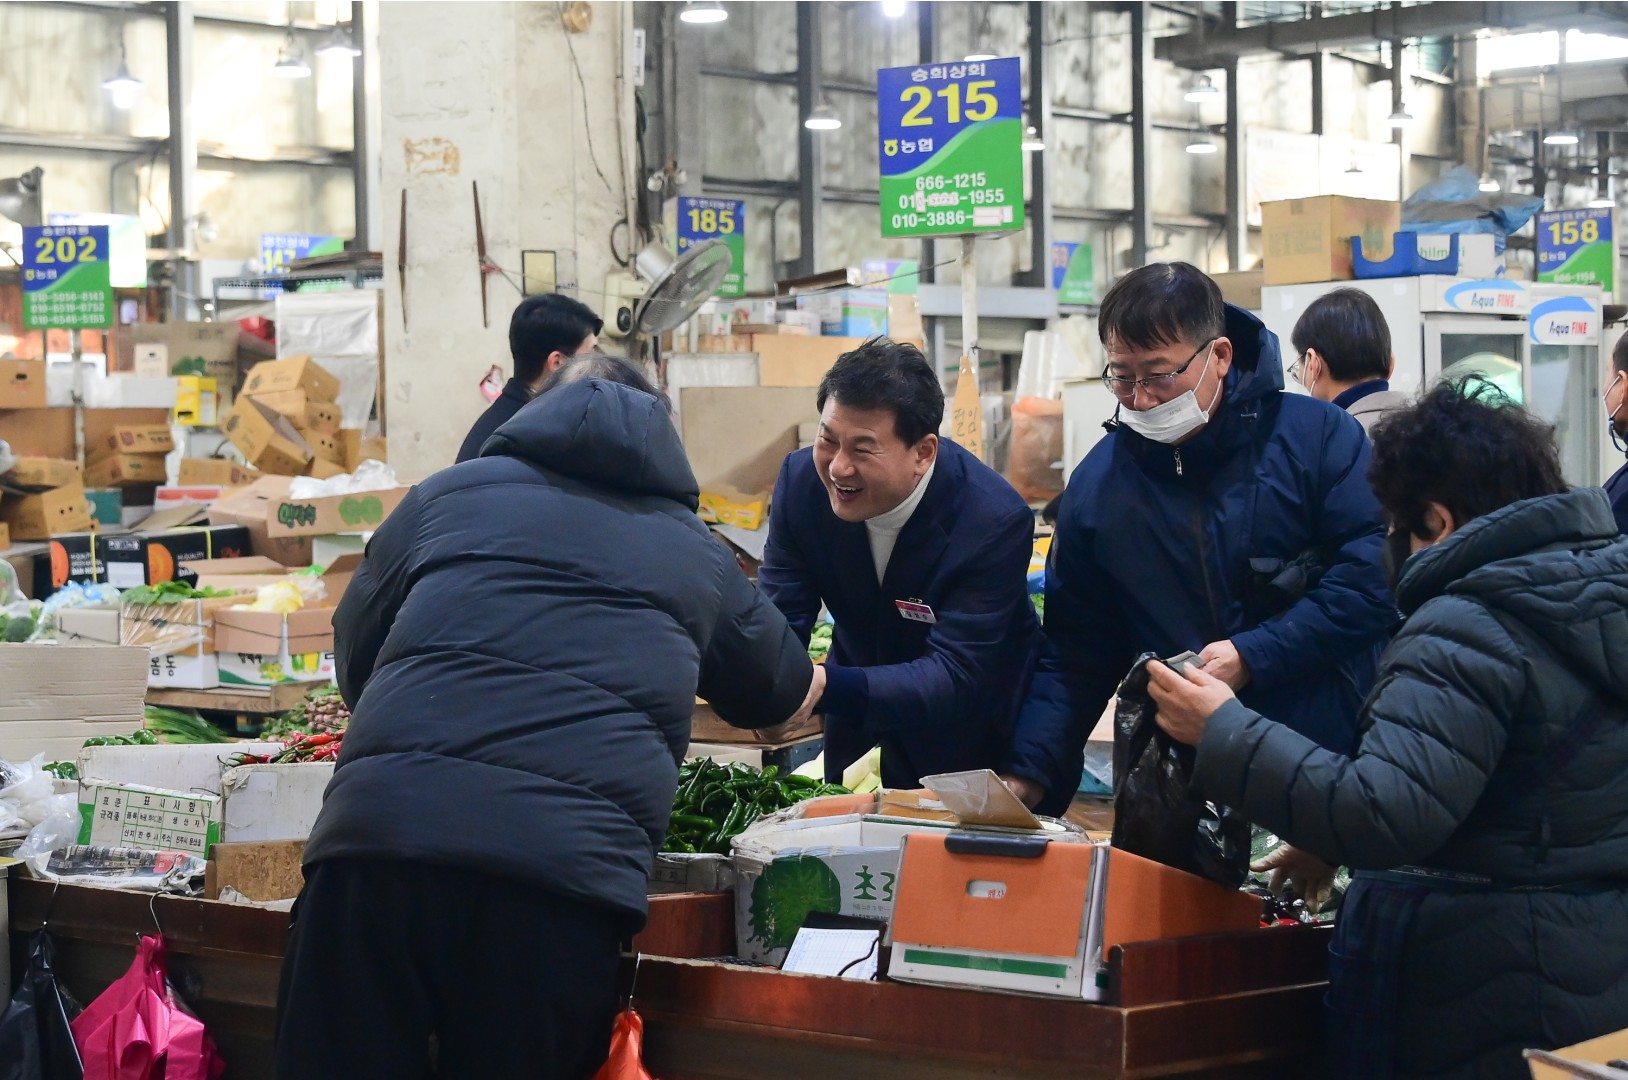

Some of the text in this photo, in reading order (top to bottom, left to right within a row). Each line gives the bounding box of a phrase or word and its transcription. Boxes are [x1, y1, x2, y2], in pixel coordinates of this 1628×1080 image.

[900, 80, 999, 127] 215
[901, 138, 933, 154] 농협
[915, 173, 986, 191] 666-1215
[898, 188, 1005, 210] 010--1955
[688, 208, 736, 234] 185
[1548, 219, 1599, 246] 158
[35, 236, 98, 264] 202
[1471, 293, 1516, 308] Aqua FINE
[1549, 321, 1588, 336] Aqua FINE
